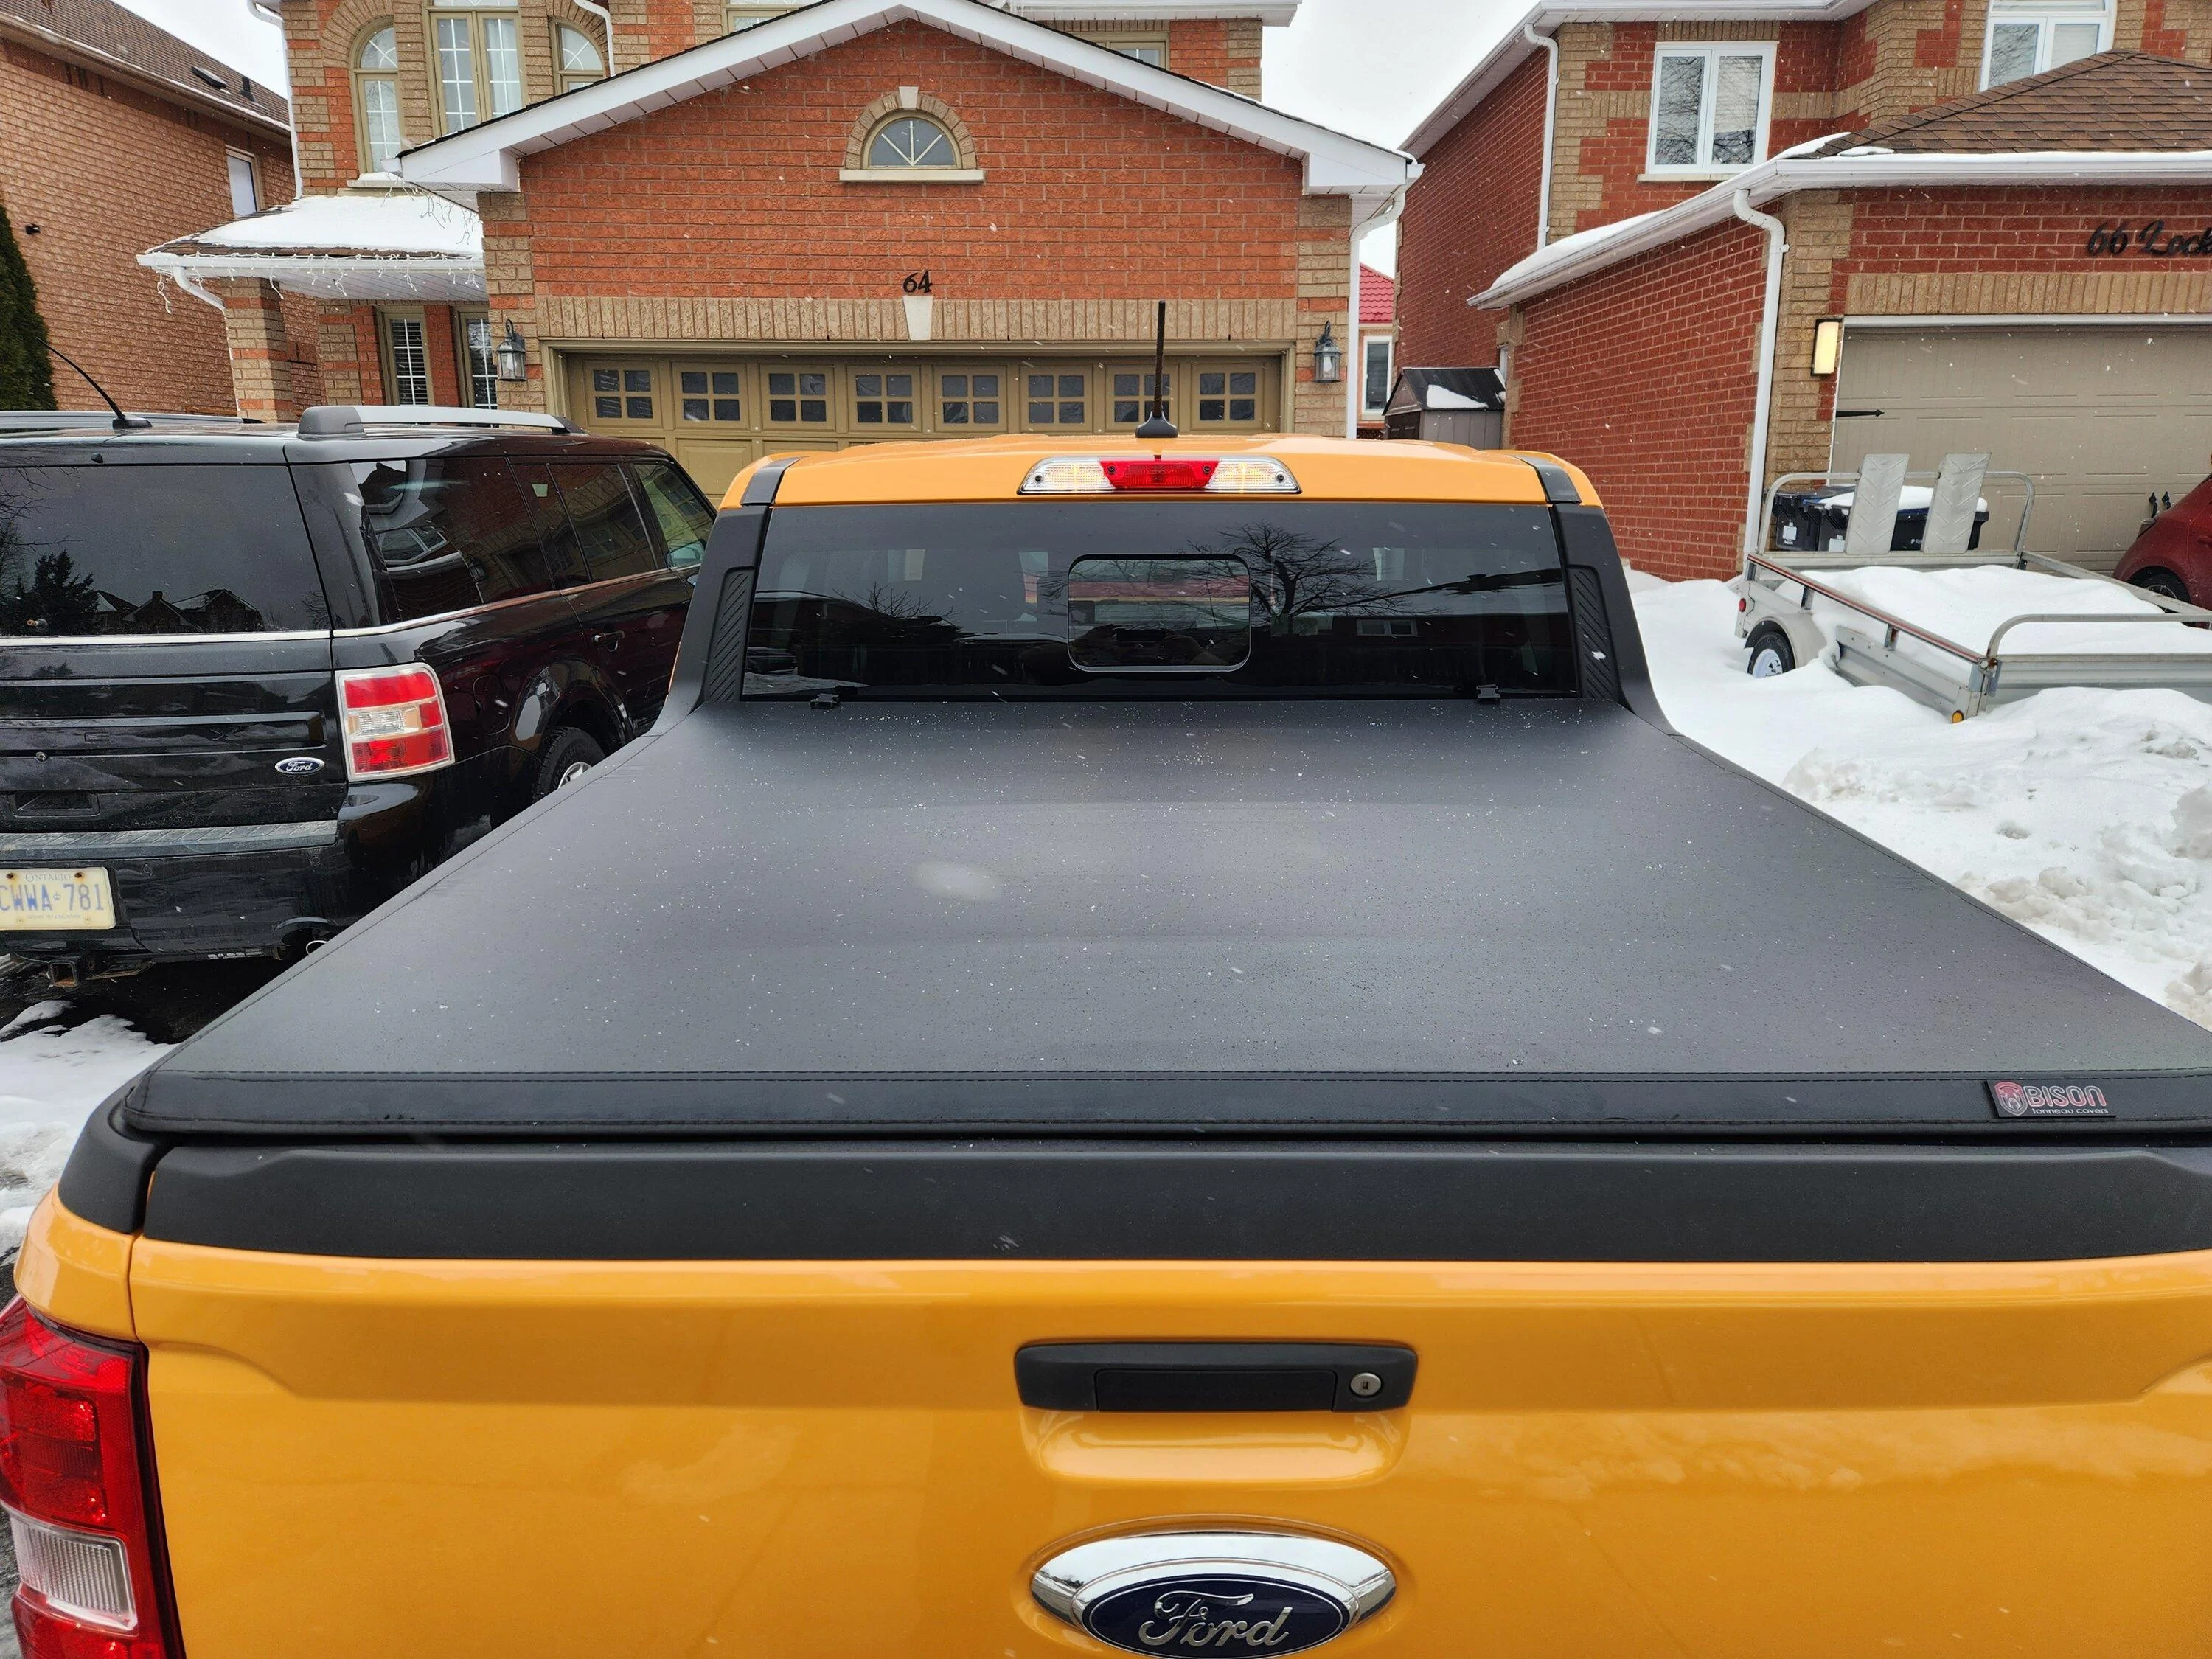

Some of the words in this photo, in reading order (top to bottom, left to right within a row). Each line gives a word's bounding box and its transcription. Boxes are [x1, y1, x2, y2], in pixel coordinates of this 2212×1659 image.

[2087, 221, 2129, 256] 66
[903, 270, 933, 293] 64
[286, 761, 313, 771] Ford
[25, 872, 72, 882] ONTARIO
[2023, 1085, 2107, 1107] BISON
[1138, 1590, 1293, 1647] Ford
